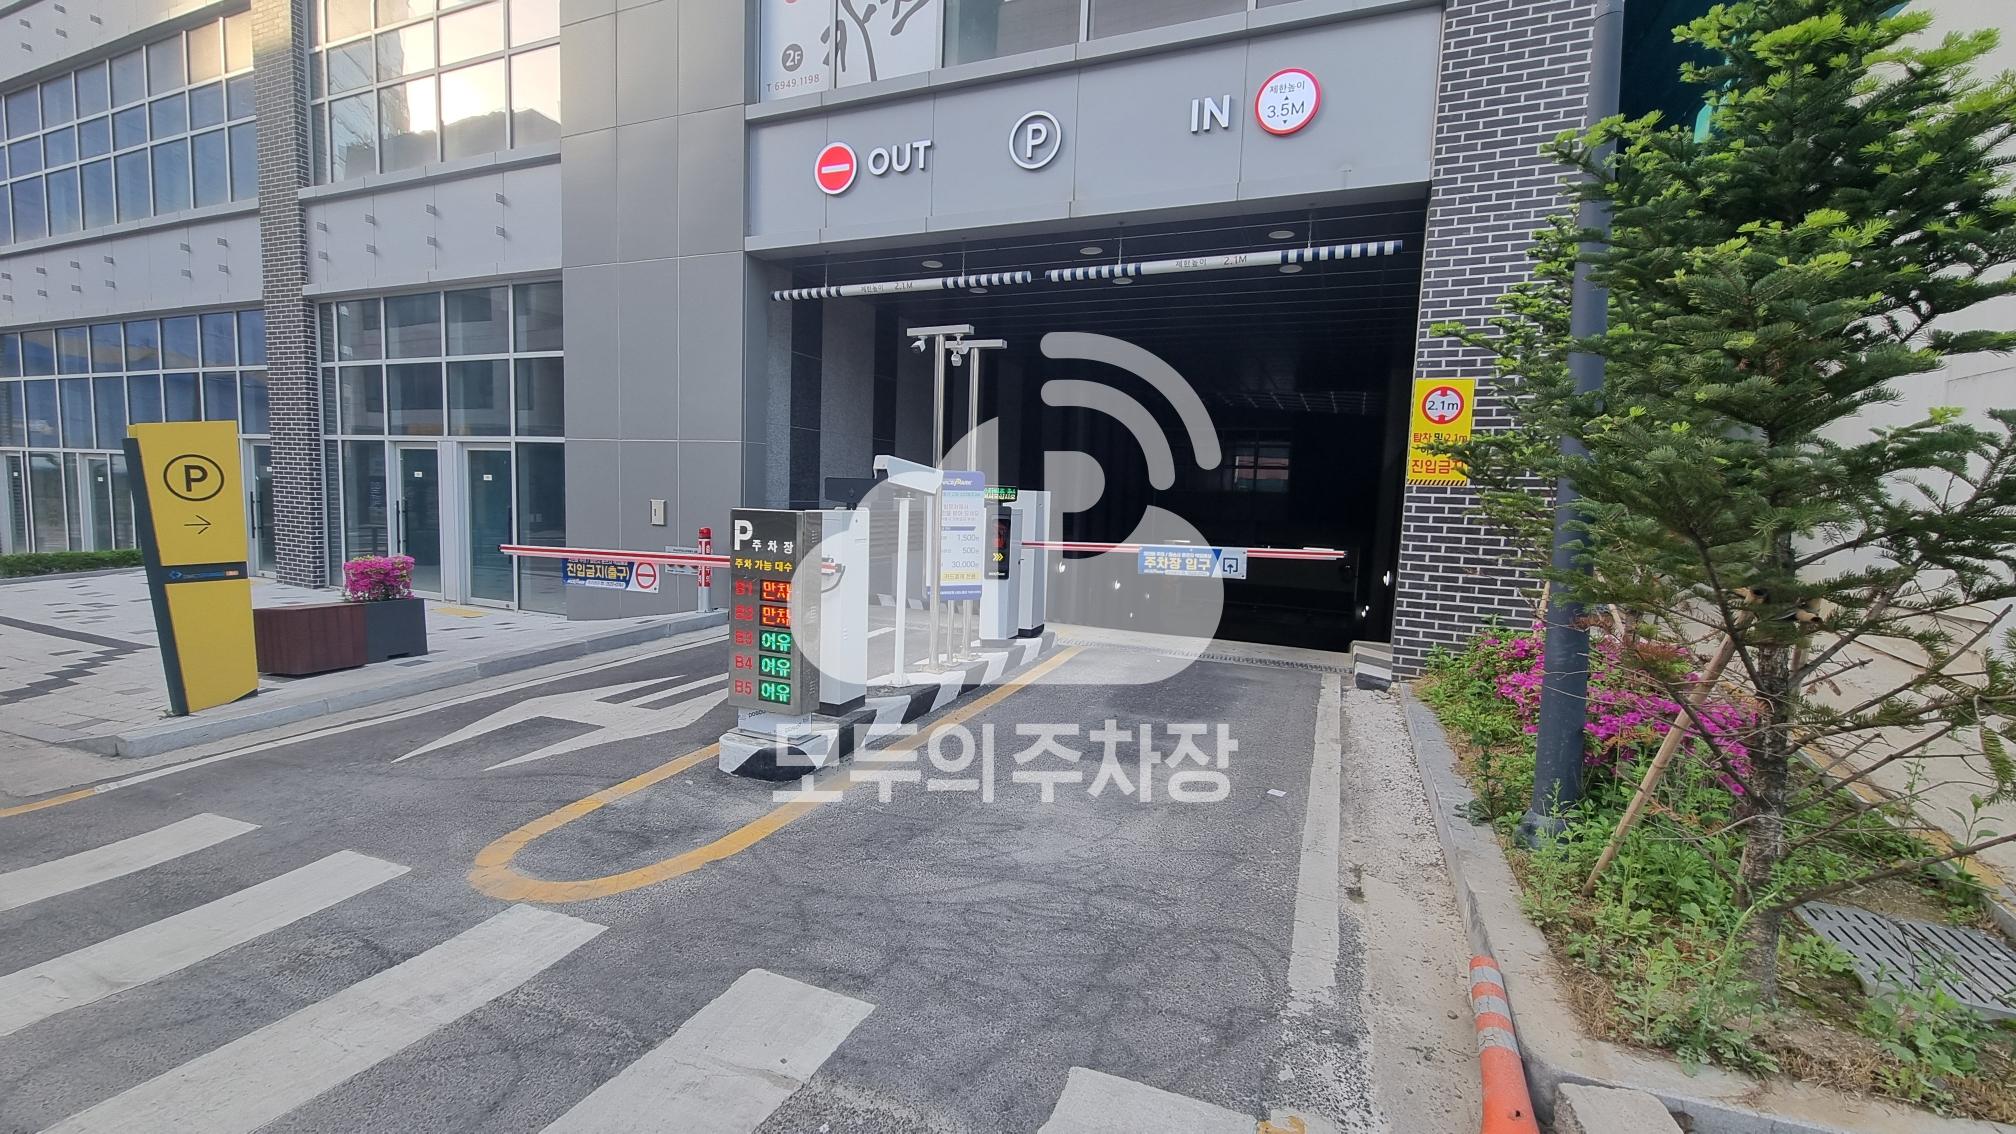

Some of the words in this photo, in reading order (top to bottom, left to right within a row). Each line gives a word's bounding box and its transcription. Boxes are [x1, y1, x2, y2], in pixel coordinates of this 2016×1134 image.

[785, 50, 802, 66] 2F
[774, 74, 820, 91] 6949.1198
[1269, 81, 1305, 94] 제한높이
[1190, 94, 1231, 133] IN
[1267, 100, 1305, 119] 3.5M
[1025, 122, 1048, 159] P
[867, 139, 932, 176] OUT
[1223, 254, 1247, 266] 2.1M
[1427, 400, 1459, 411] 2.1m
[184, 464, 208, 492] P
[734, 519, 753, 551] P
[566, 562, 630, 581] 진입금지(출구)
[735, 558, 752, 570] 주차
[754, 560, 773, 571] 가능
[774, 561, 793, 573] 대수
[1143, 556, 1182, 570] 주차장
[1186, 557, 1211, 571] 입구
[735, 655, 753, 670] B4
[734, 680, 752, 696] B5
